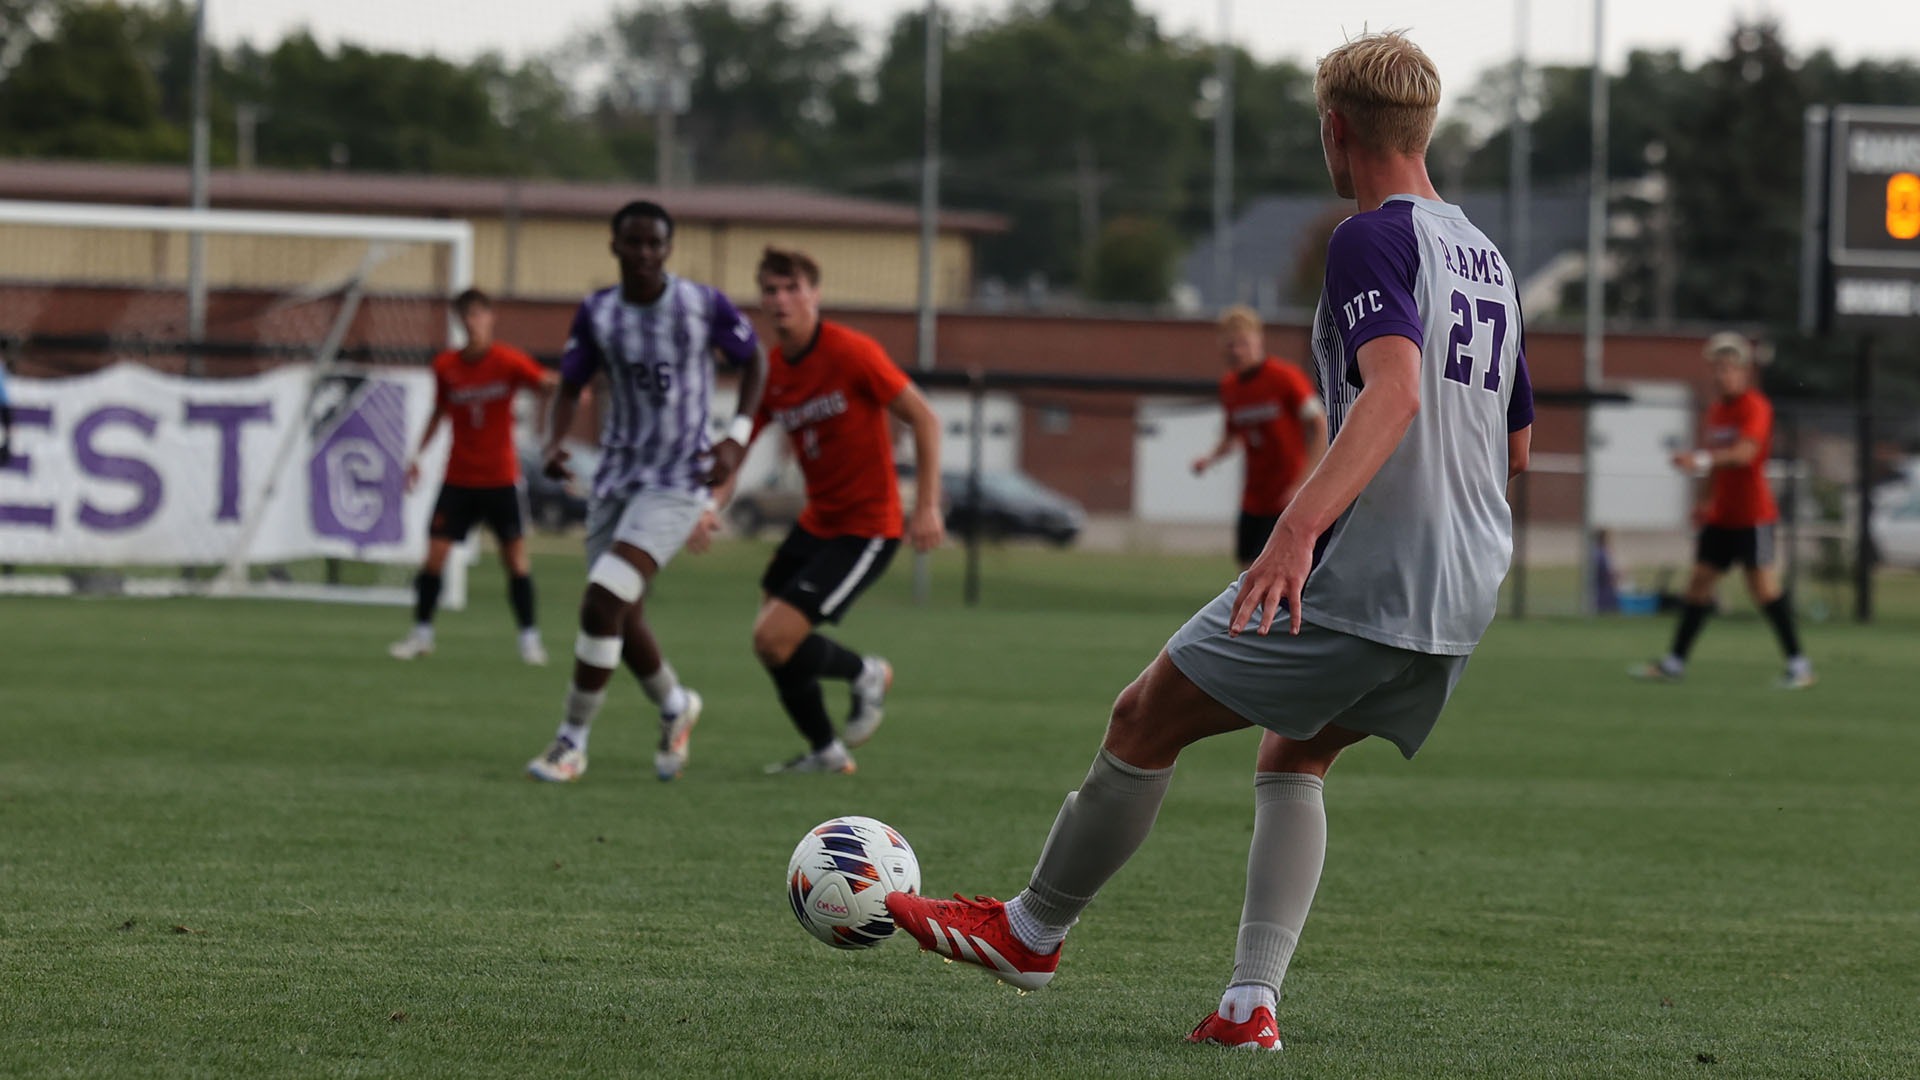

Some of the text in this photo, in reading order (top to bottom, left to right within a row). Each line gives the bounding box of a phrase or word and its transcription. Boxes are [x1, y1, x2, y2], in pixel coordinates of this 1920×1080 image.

[1438, 236, 1504, 287] RAMS
[1343, 289, 1384, 330] DTC
[1443, 286, 1509, 393] 27
[0, 402, 273, 534] EST
